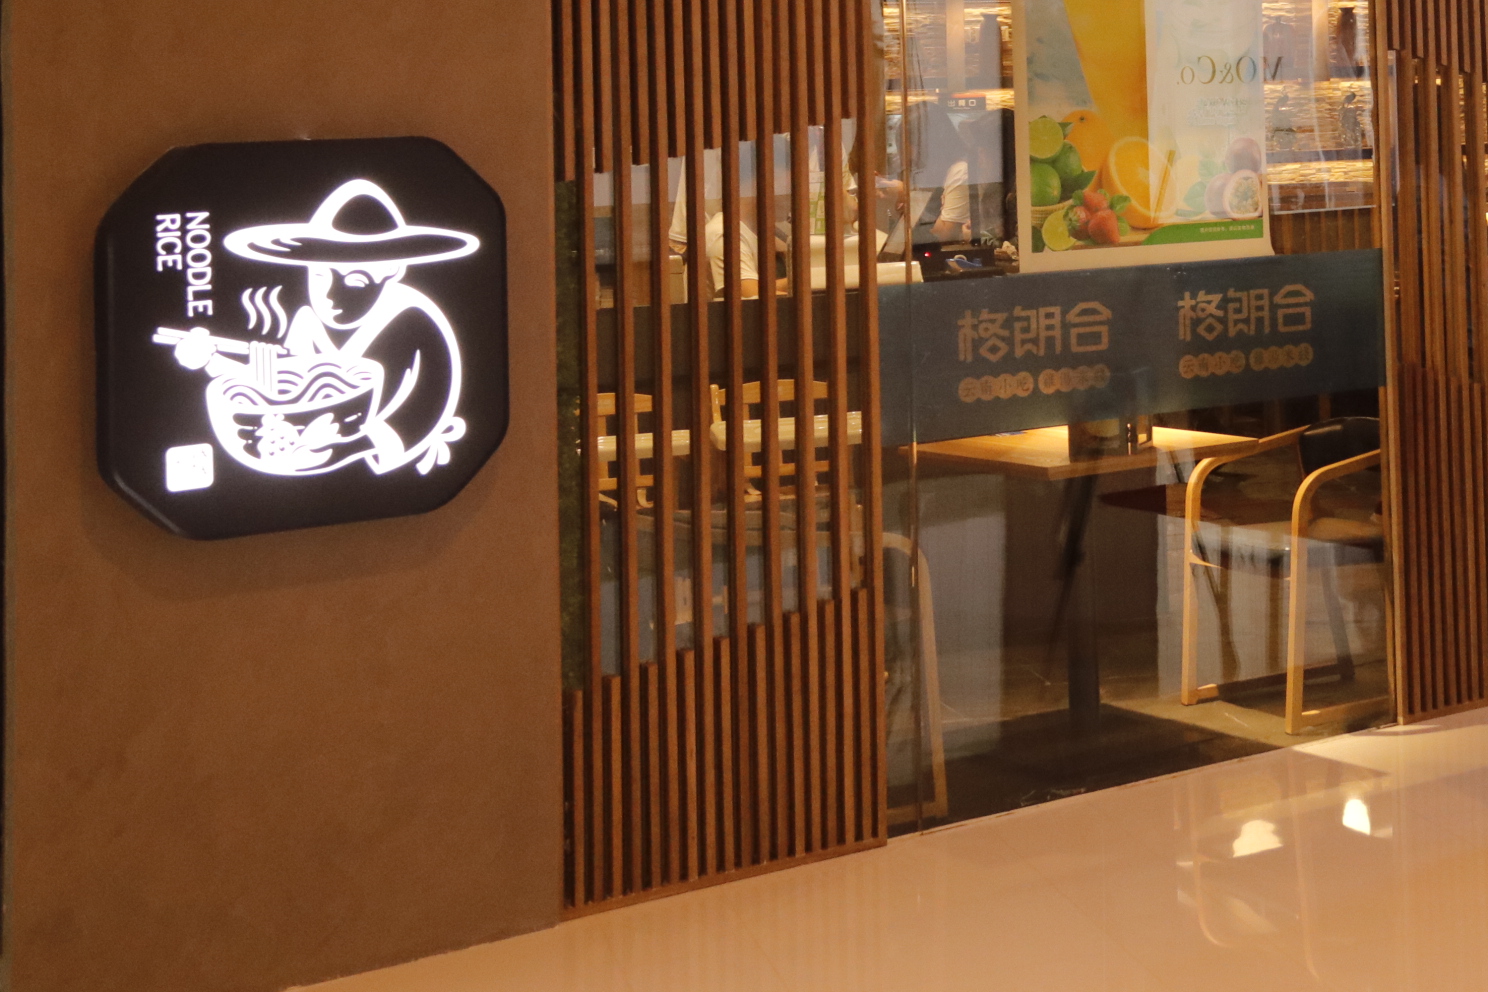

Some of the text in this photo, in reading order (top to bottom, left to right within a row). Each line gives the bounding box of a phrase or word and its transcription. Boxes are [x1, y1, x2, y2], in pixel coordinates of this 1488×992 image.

[155, 213, 183, 272] RICE
[187, 211, 213, 317] NOODLE
[957, 301, 1113, 362] 格朗合
[1177, 284, 1315, 342] 格朗合
